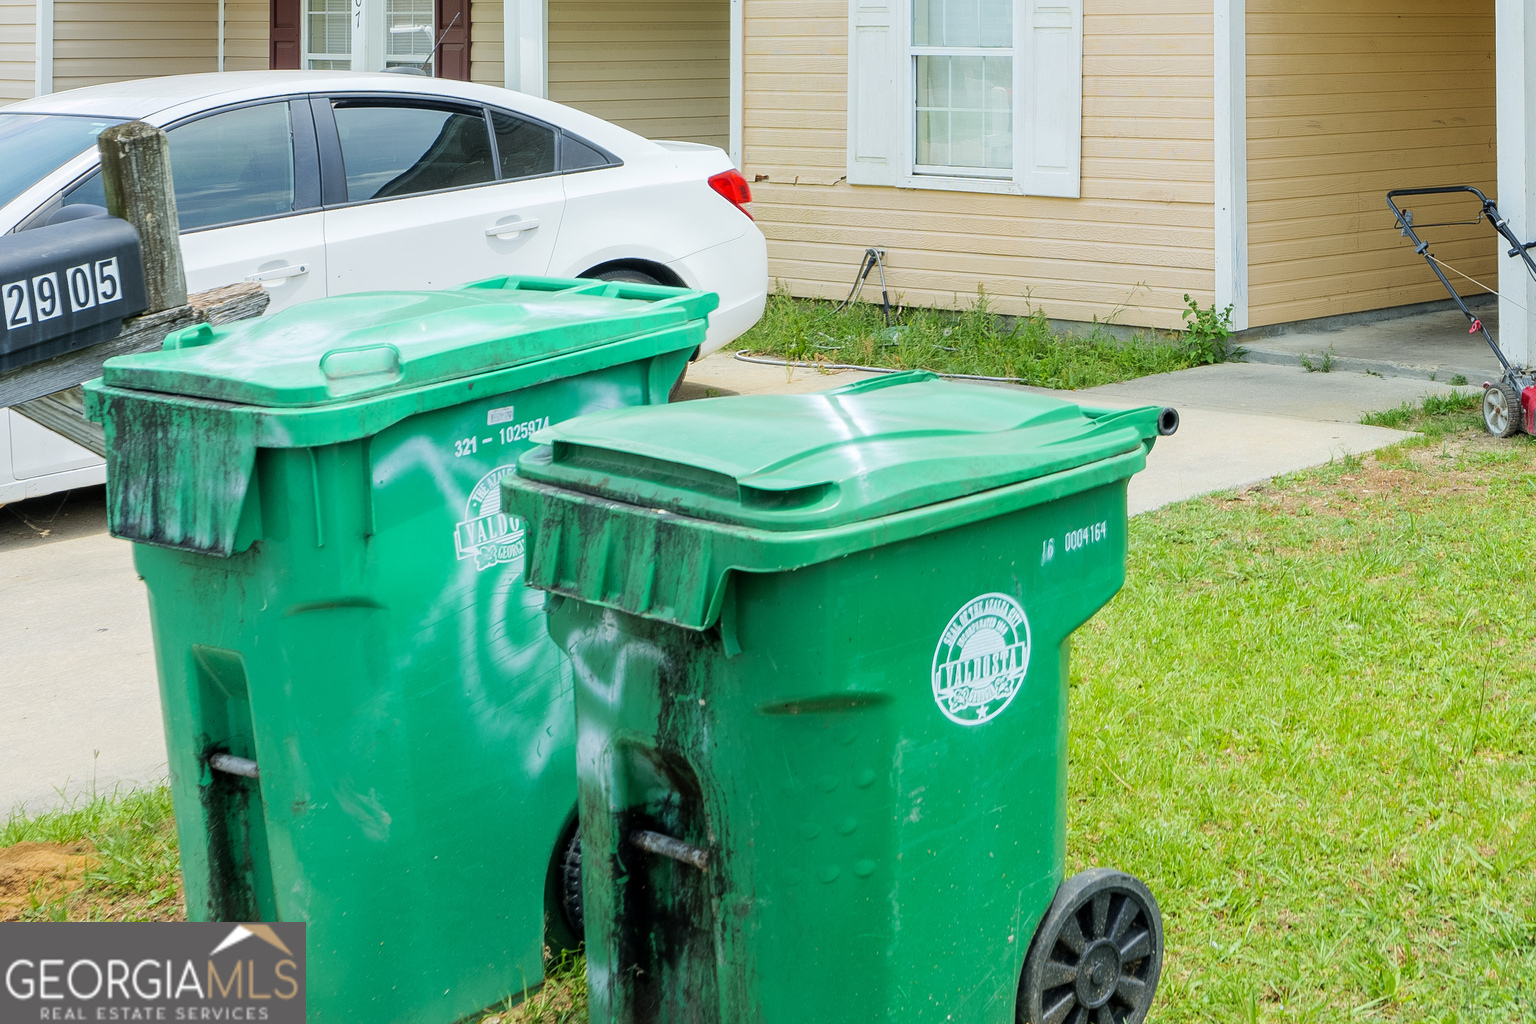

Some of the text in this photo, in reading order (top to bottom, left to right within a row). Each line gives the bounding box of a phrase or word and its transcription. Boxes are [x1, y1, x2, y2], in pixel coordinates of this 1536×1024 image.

[7, 259, 117, 326] 2905
[454, 435, 477, 458] 321
[499, 416, 550, 445] 1025974
[471, 467, 517, 503] THE AZALE
[465, 513, 520, 545] VALDO
[1065, 520, 1107, 553] 0004164
[497, 538, 525, 559] GEORGI
[946, 647, 1018, 690] VALDOSTA
